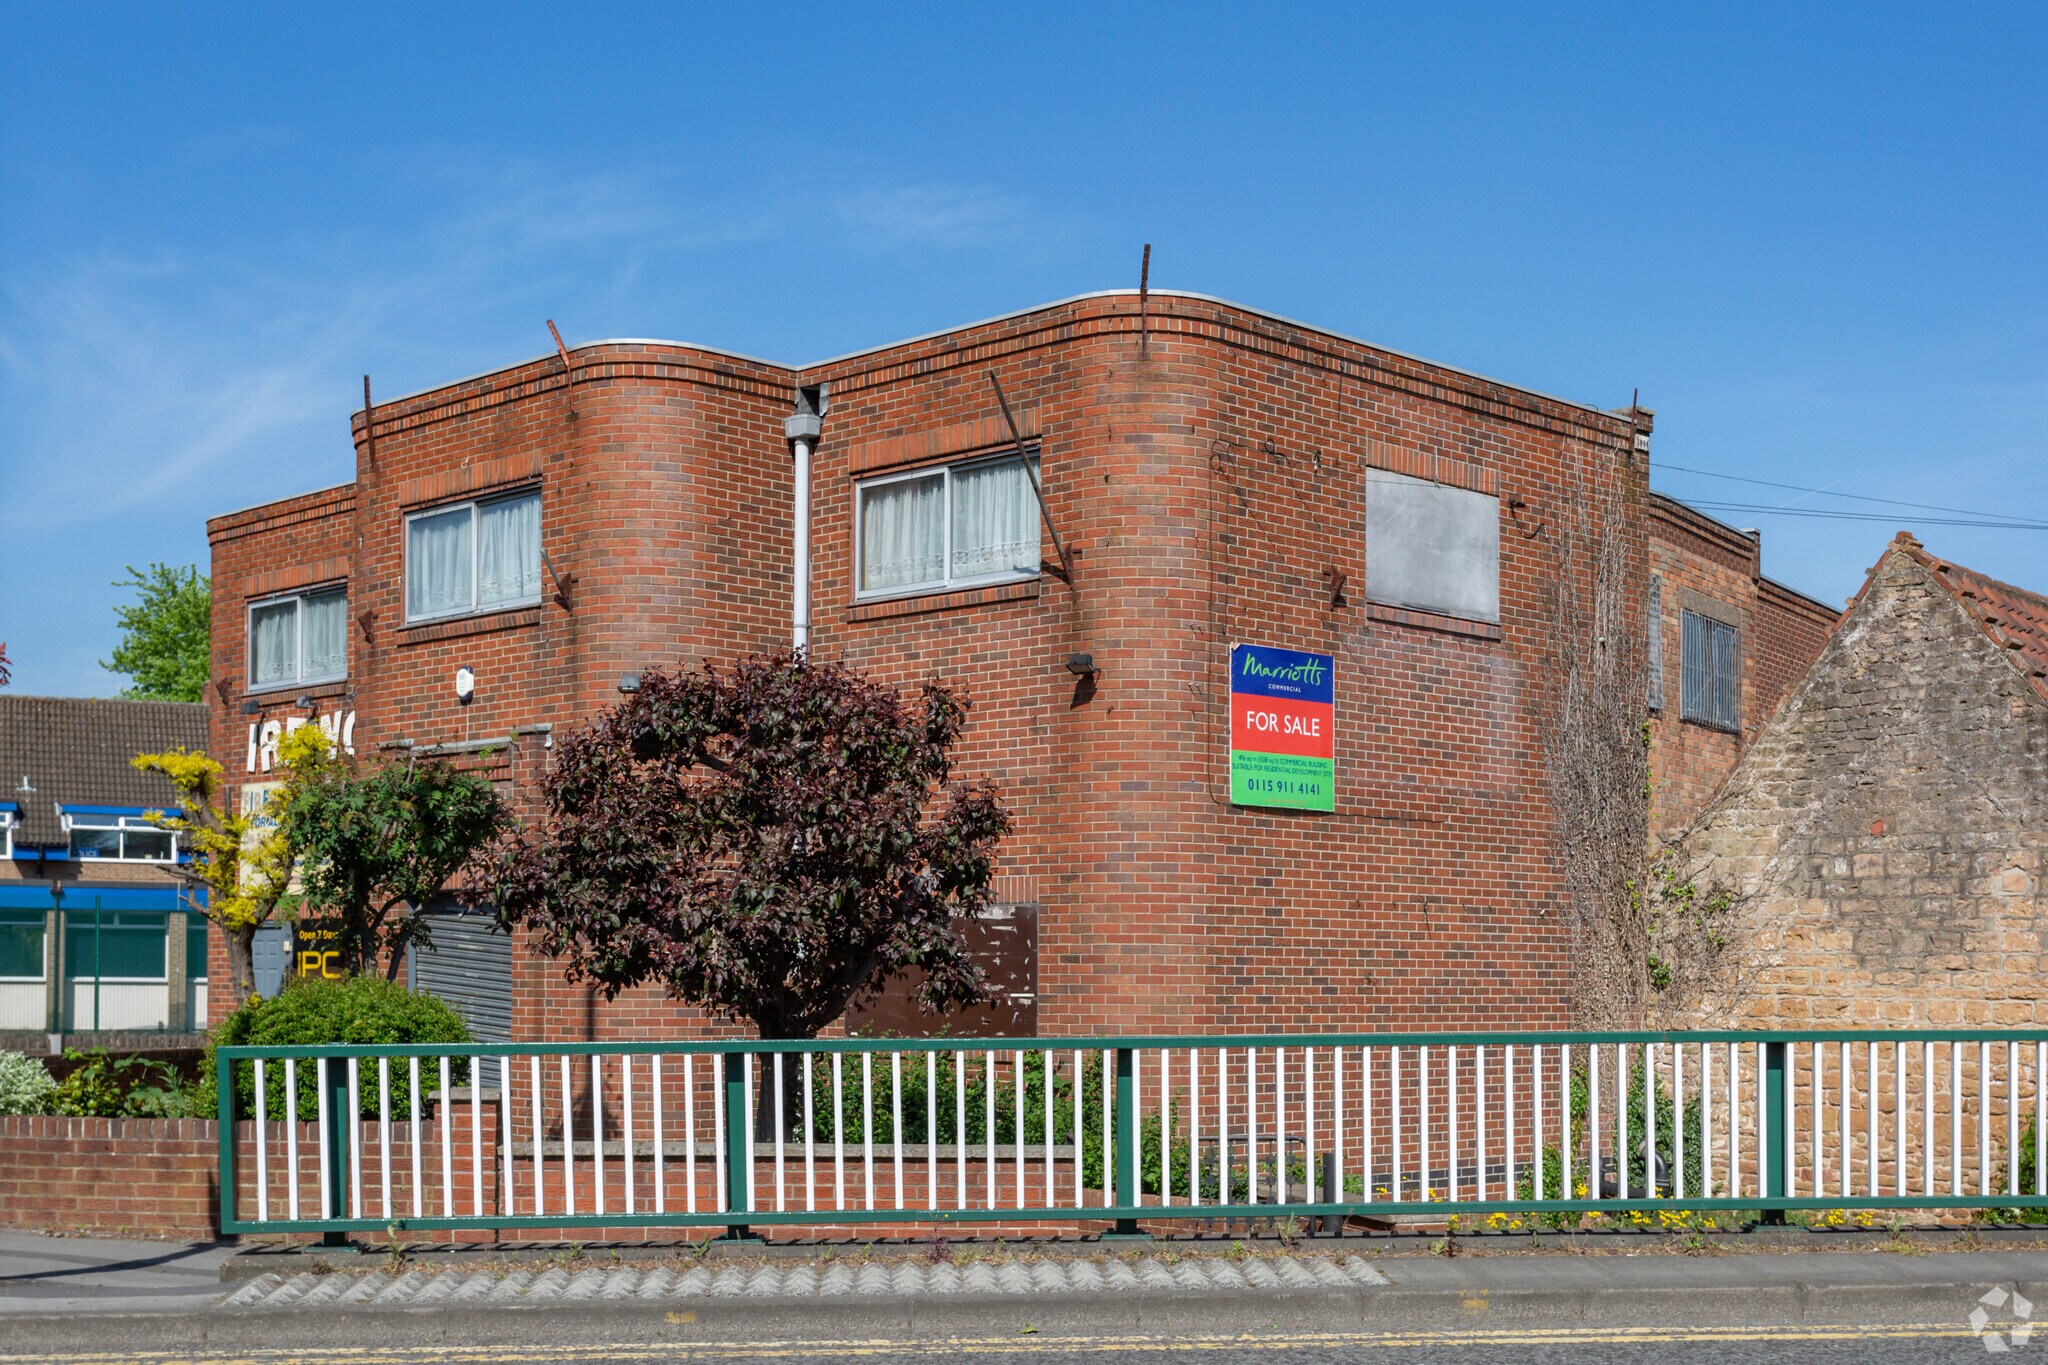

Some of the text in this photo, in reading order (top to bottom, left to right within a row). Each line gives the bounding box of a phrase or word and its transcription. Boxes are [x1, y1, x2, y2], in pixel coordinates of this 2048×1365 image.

[1243, 652, 1327, 686] Marriotts
[1268, 683, 1301, 693] COMMERCIAL
[1247, 711, 1320, 737] FOR SALE
[1248, 778, 1320, 795] 0115 911 4141
[299, 930, 316, 941] Open
[317, 930, 322, 939] 7
